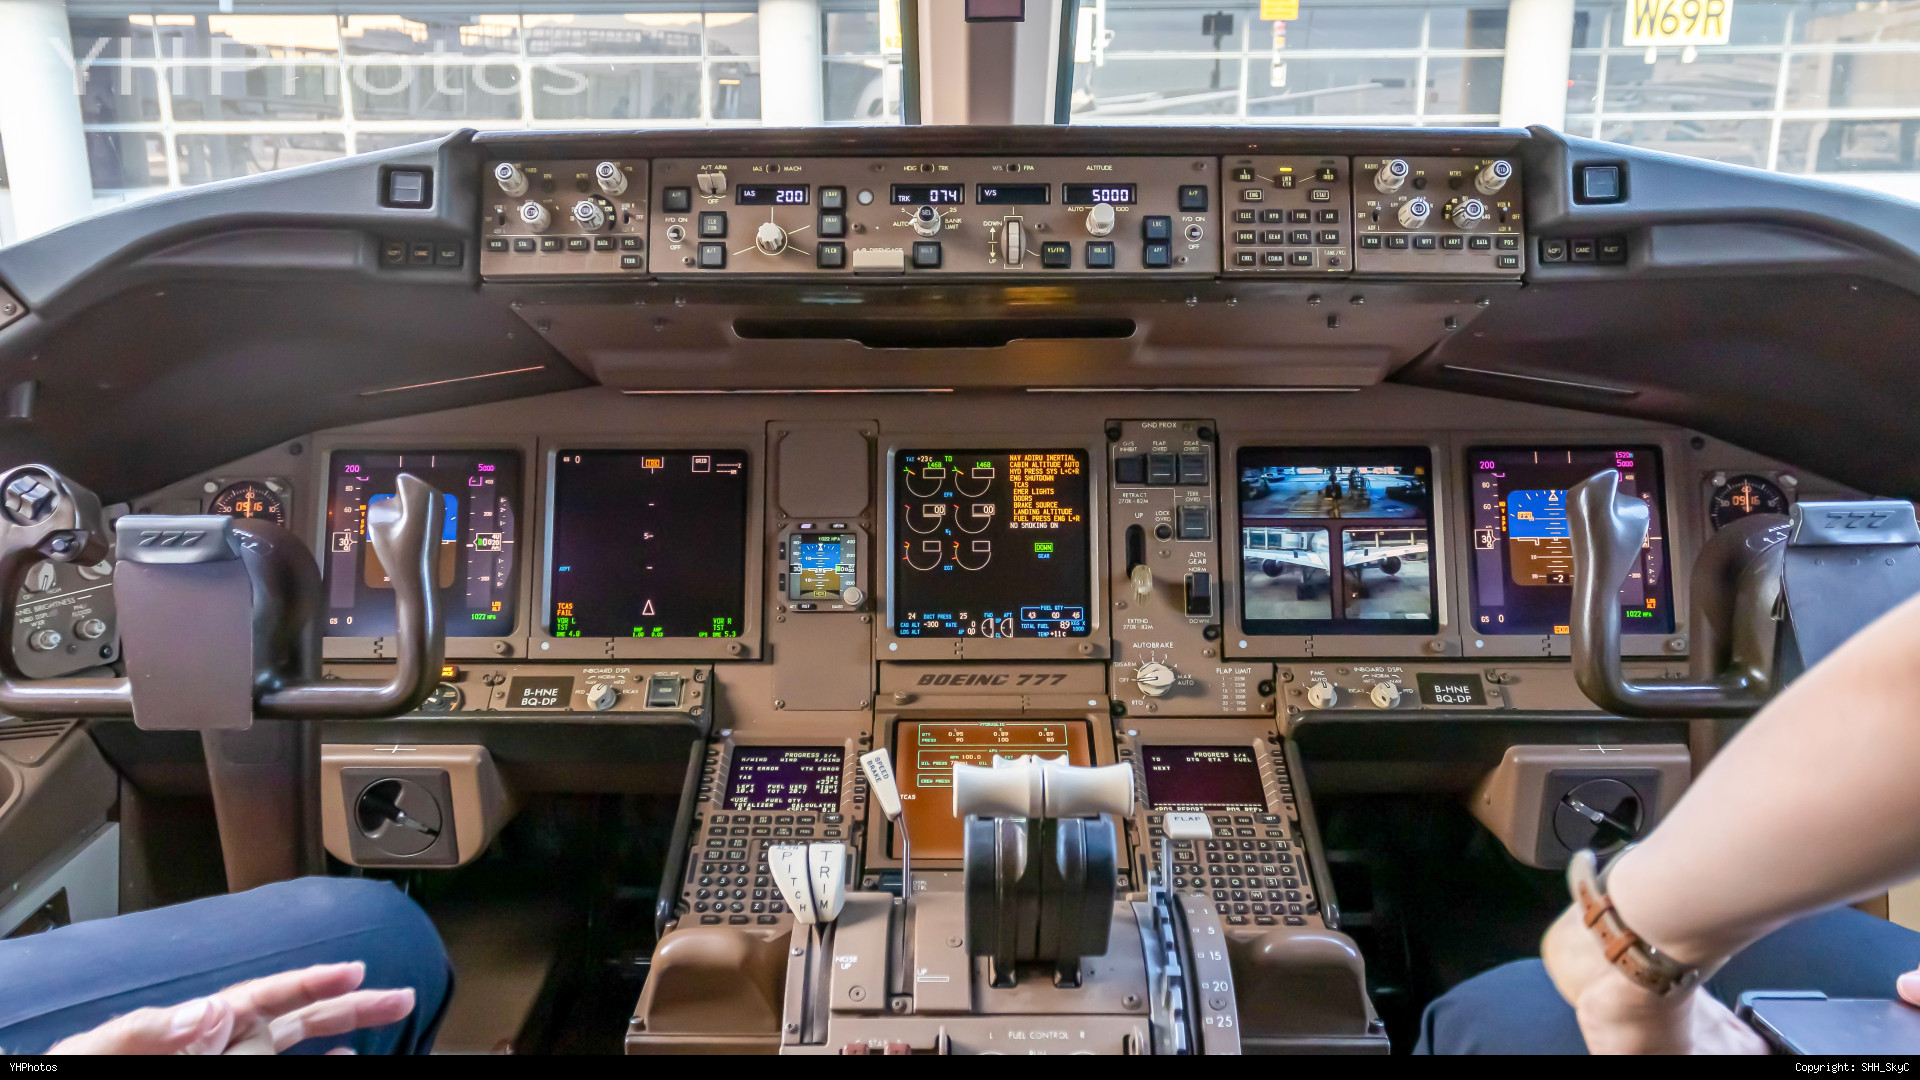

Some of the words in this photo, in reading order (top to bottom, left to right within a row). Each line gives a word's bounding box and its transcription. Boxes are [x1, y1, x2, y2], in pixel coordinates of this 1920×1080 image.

[1633, 0, 1724, 37] W69R
[776, 190, 803, 202] 200
[930, 190, 957, 202] 074
[1093, 190, 1129, 202] 5000
[1480, 461, 1495, 469] 200
[138, 531, 205, 546] 777
[917, 674, 1010, 686] BOEING
[1016, 674, 1068, 686] 777
[524, 688, 558, 697] B-HNE
[1434, 686, 1469, 694] B-HNE
[521, 697, 556, 706] BQ-DP
[1436, 694, 1472, 703] BQ-DP
[867, 761, 882, 783] BRAKE
[875, 757, 889, 779] SPEED
[782, 852, 806, 913] PITCH
[820, 851, 832, 909] TRIM
[1210, 952, 1221, 960] 15
[1213, 982, 1228, 991] 20
[1217, 1017, 1233, 1027] 25
